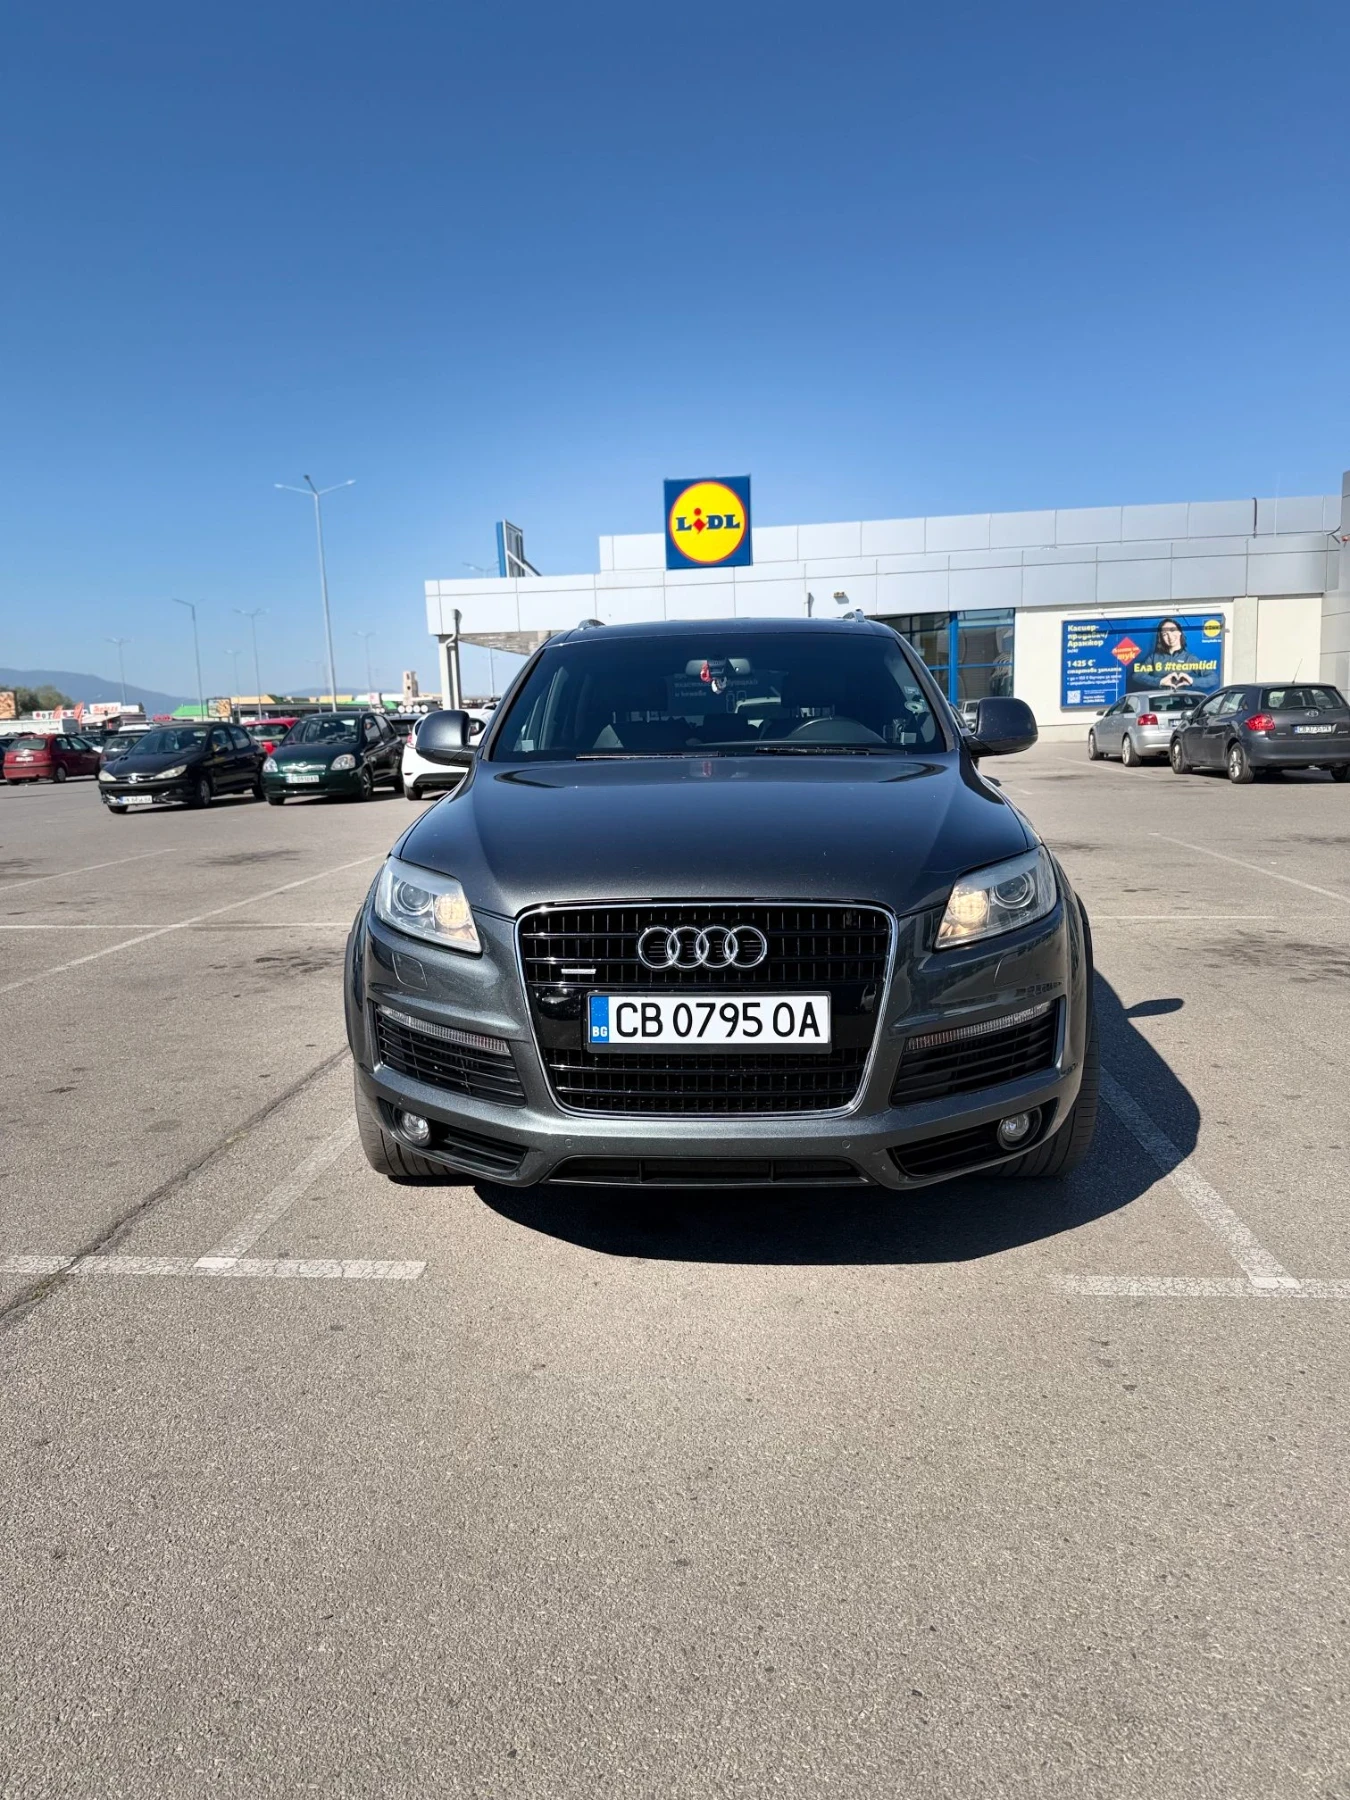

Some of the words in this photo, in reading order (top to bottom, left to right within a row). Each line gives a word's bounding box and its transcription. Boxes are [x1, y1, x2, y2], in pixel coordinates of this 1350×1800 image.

[676, 508, 740, 534] LIDL
[1165, 660, 1217, 671] #teamlidl
[616, 1002, 664, 1038] CB
[672, 1002, 763, 1038] 0795
[592, 1026, 608, 1037] BG
